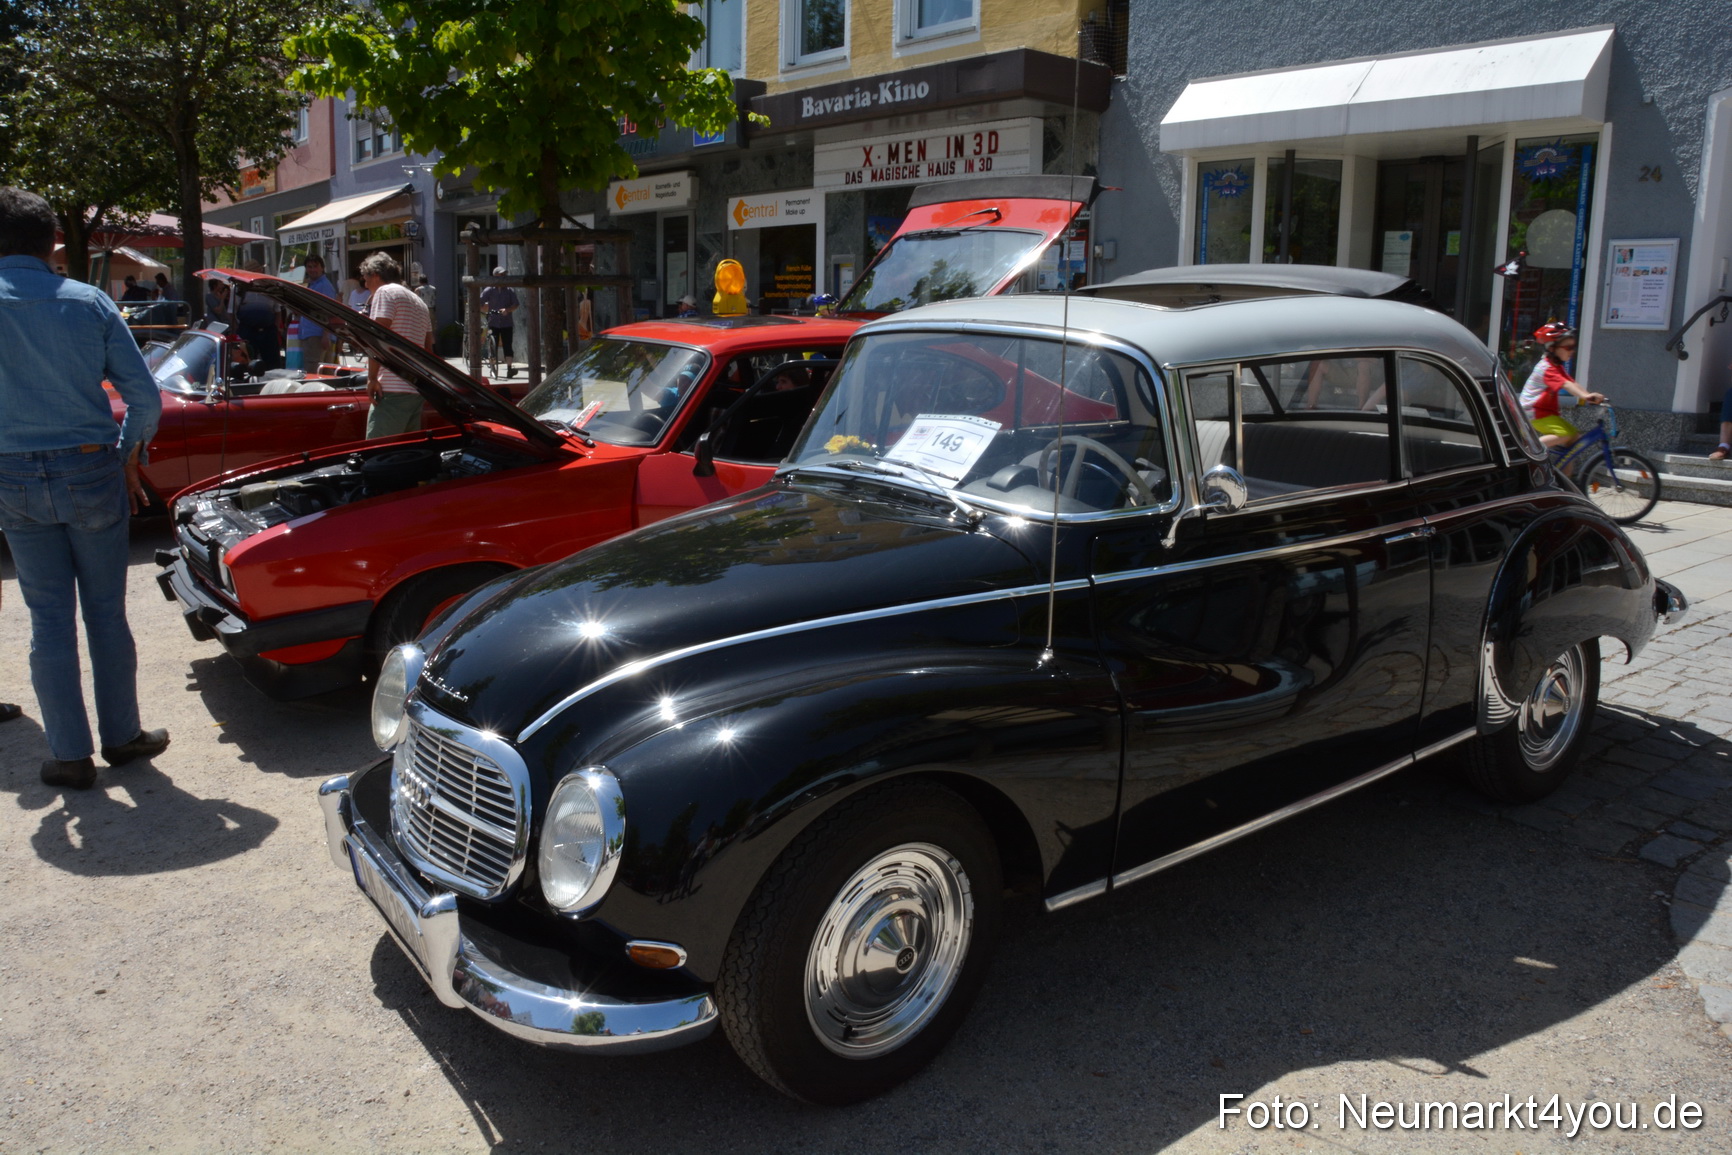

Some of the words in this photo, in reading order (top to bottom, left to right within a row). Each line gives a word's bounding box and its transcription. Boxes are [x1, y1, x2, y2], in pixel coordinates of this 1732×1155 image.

[802, 80, 930, 118] Bavaria-Kino
[946, 134, 965, 159] IN
[973, 130, 999, 156] 3D
[845, 170, 863, 185] DAS
[870, 164, 921, 183] MAGISCHE
[927, 160, 956, 177] HAUS
[964, 159, 975, 174] IN
[978, 156, 993, 172] 3D
[1638, 166, 1662, 182] 24
[785, 197, 810, 206] Permanent
[799, 208, 806, 216] up
[932, 431, 965, 452] 149
